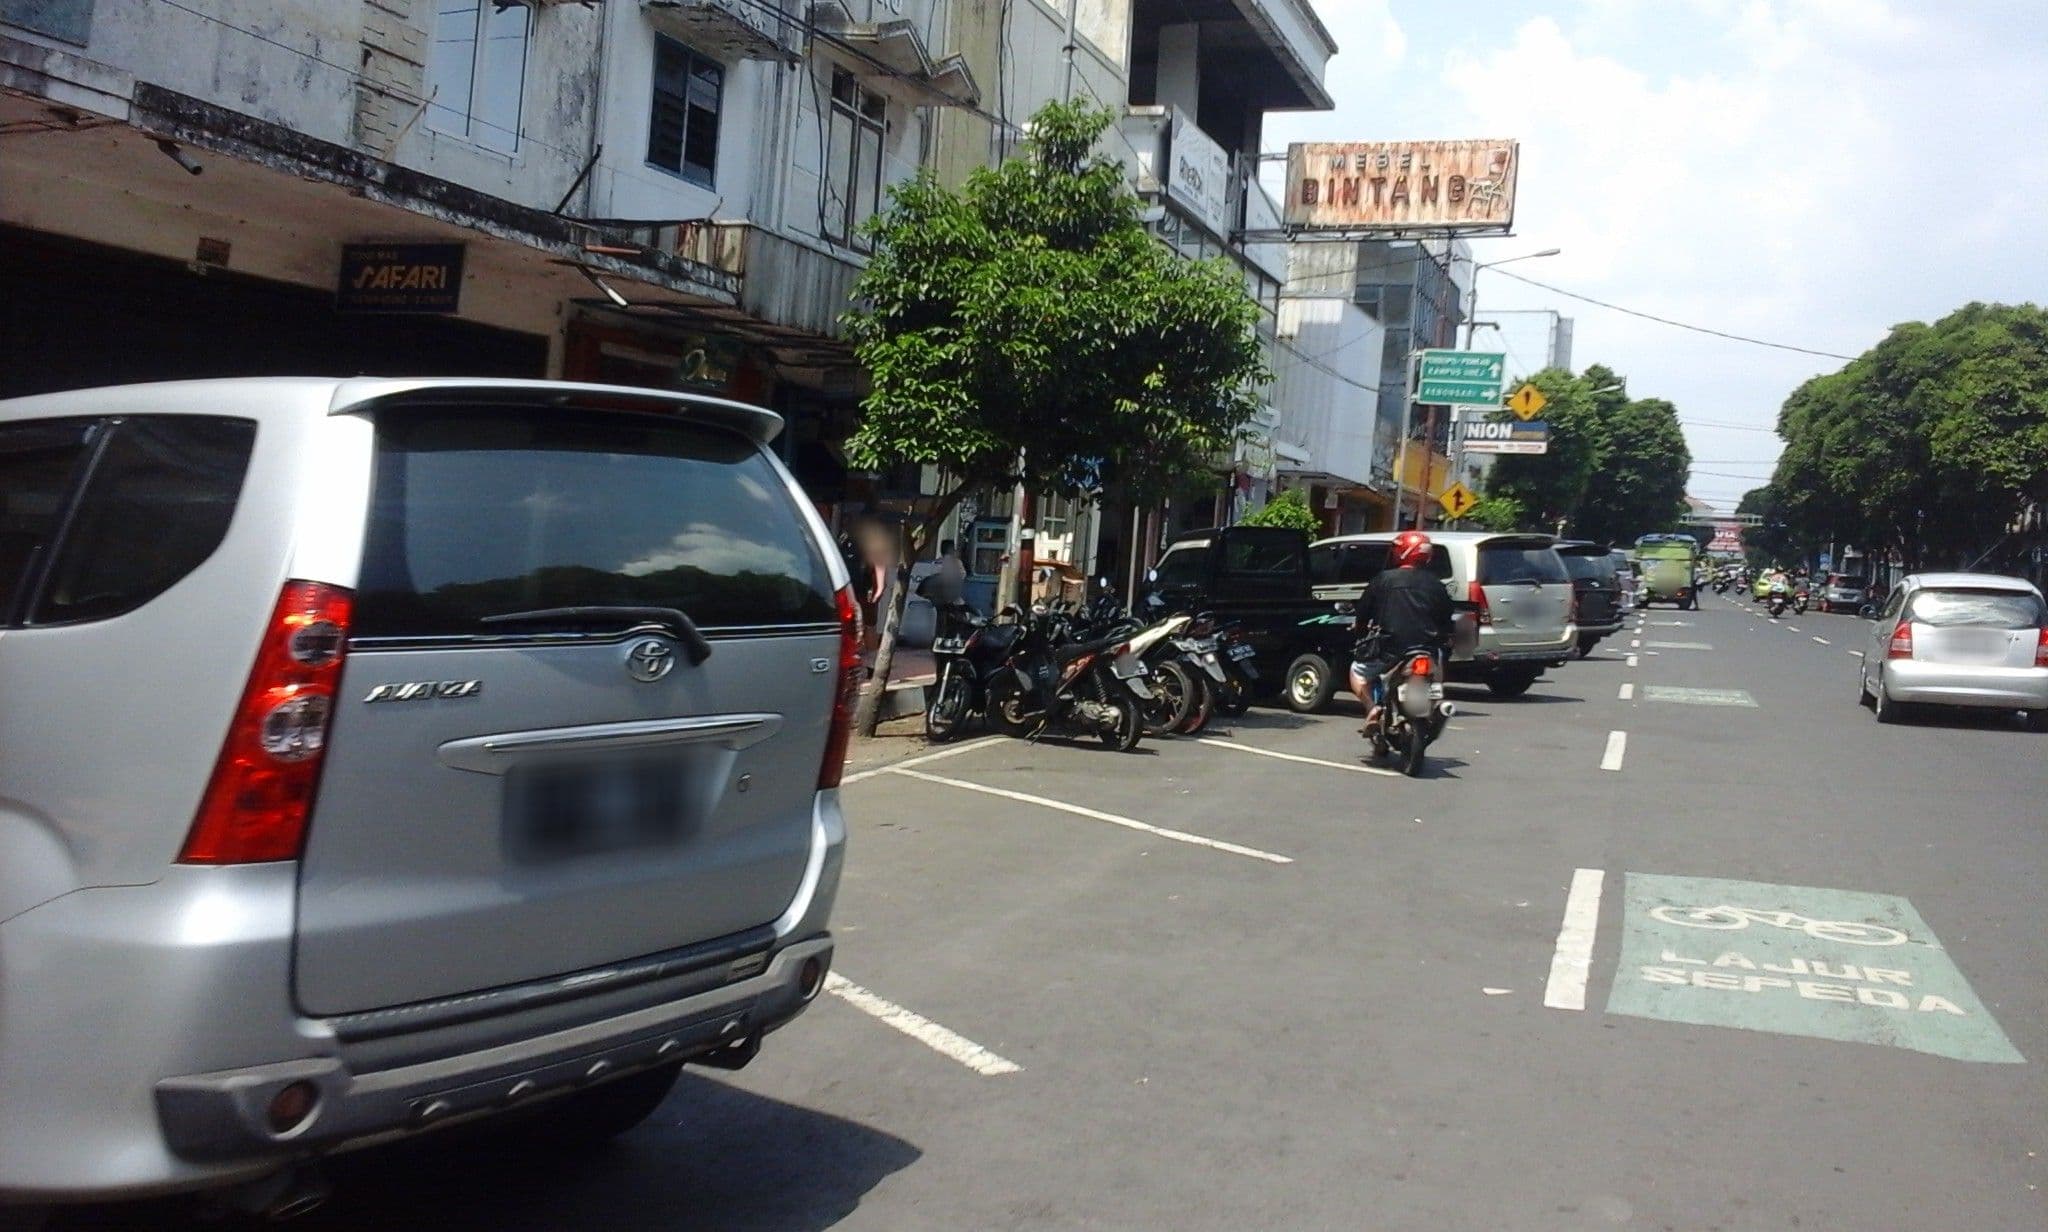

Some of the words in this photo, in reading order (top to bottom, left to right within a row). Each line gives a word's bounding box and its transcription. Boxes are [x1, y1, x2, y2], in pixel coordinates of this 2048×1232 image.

[1331, 152, 1431, 171] MEBEL
[352, 265, 447, 289] SAFARI
[1661, 950, 1913, 986] LAJUR
[1640, 966, 1967, 1016] SEPEDA
